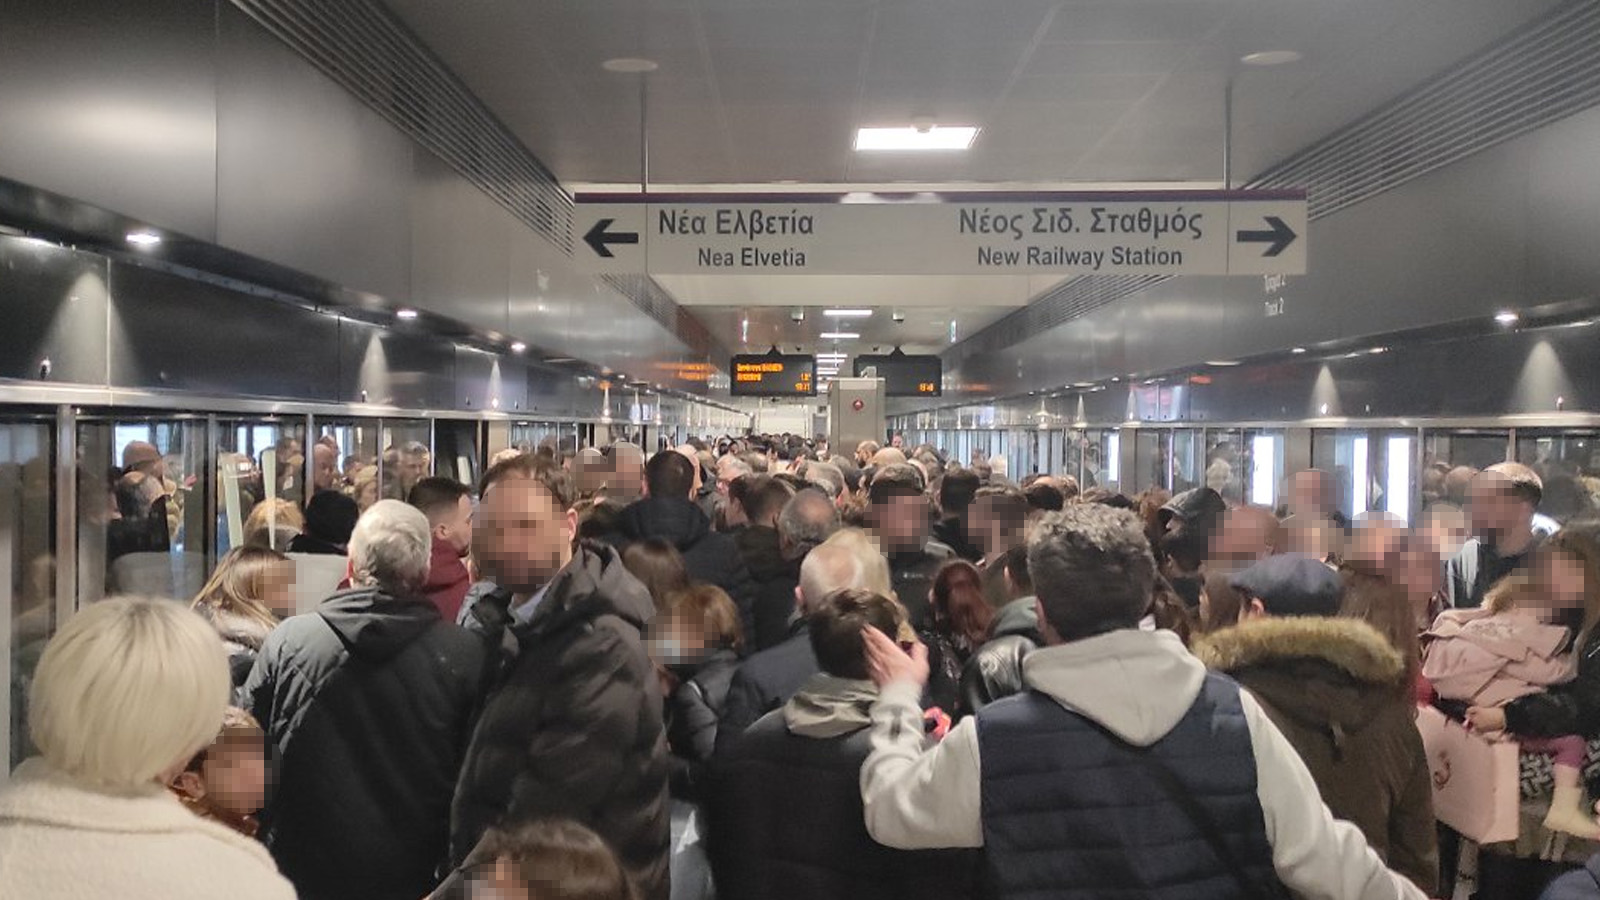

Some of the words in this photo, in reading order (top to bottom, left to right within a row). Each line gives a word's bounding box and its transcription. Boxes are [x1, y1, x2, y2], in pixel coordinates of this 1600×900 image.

[659, 208, 707, 235] Νέα
[715, 208, 814, 241] Ελβετία
[959, 207, 1024, 241] Νέος
[1032, 207, 1081, 234] Σιδ.
[1090, 206, 1203, 240] Σταθμός
[698, 247, 734, 267] Nea
[740, 246, 806, 267] Elvetia
[977, 246, 1021, 266] New
[1026, 245, 1105, 271] Railway
[1111, 245, 1183, 266] Station
